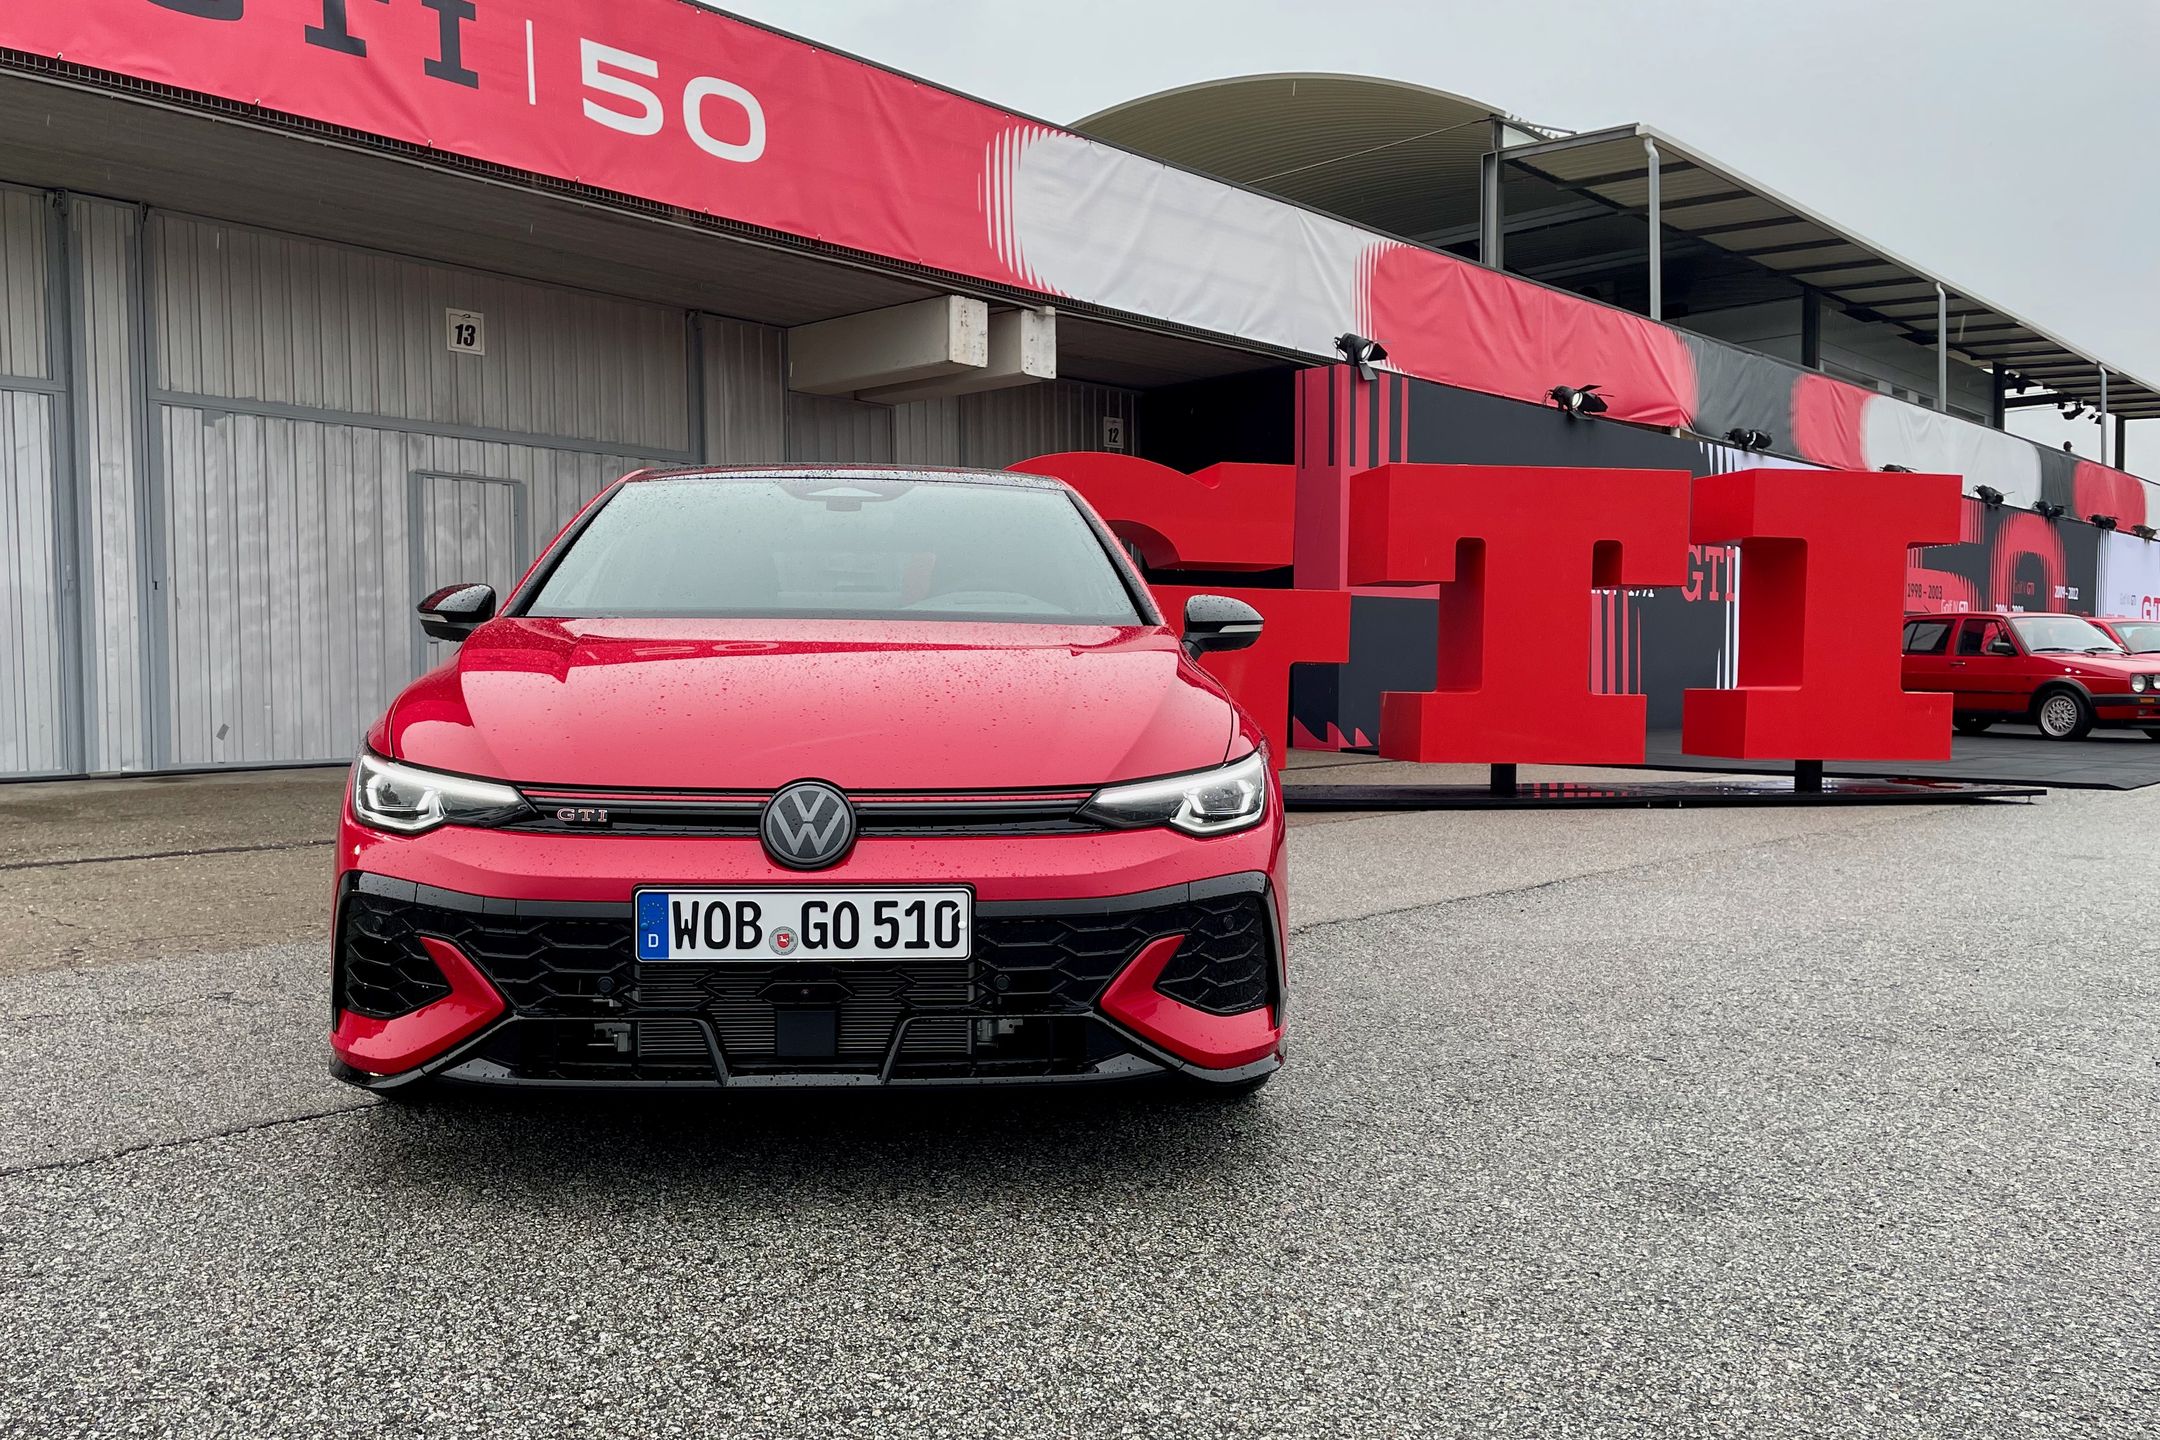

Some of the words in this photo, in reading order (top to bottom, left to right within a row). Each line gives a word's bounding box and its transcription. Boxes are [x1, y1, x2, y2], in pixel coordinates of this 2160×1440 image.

[147, 0, 479, 90] TI
[579, 37, 767, 163] 50
[454, 323, 477, 347] 13
[1107, 427, 1120, 444] 12
[1681, 544, 1735, 602] GTI
[1907, 583, 1922, 598] 1998
[1928, 584, 1943, 600] 2003
[556, 807, 608, 823] GTI
[647, 933, 660, 949] D
[672, 900, 763, 950] WOB
[801, 900, 860, 950] GO
[873, 900, 961, 950] 510
